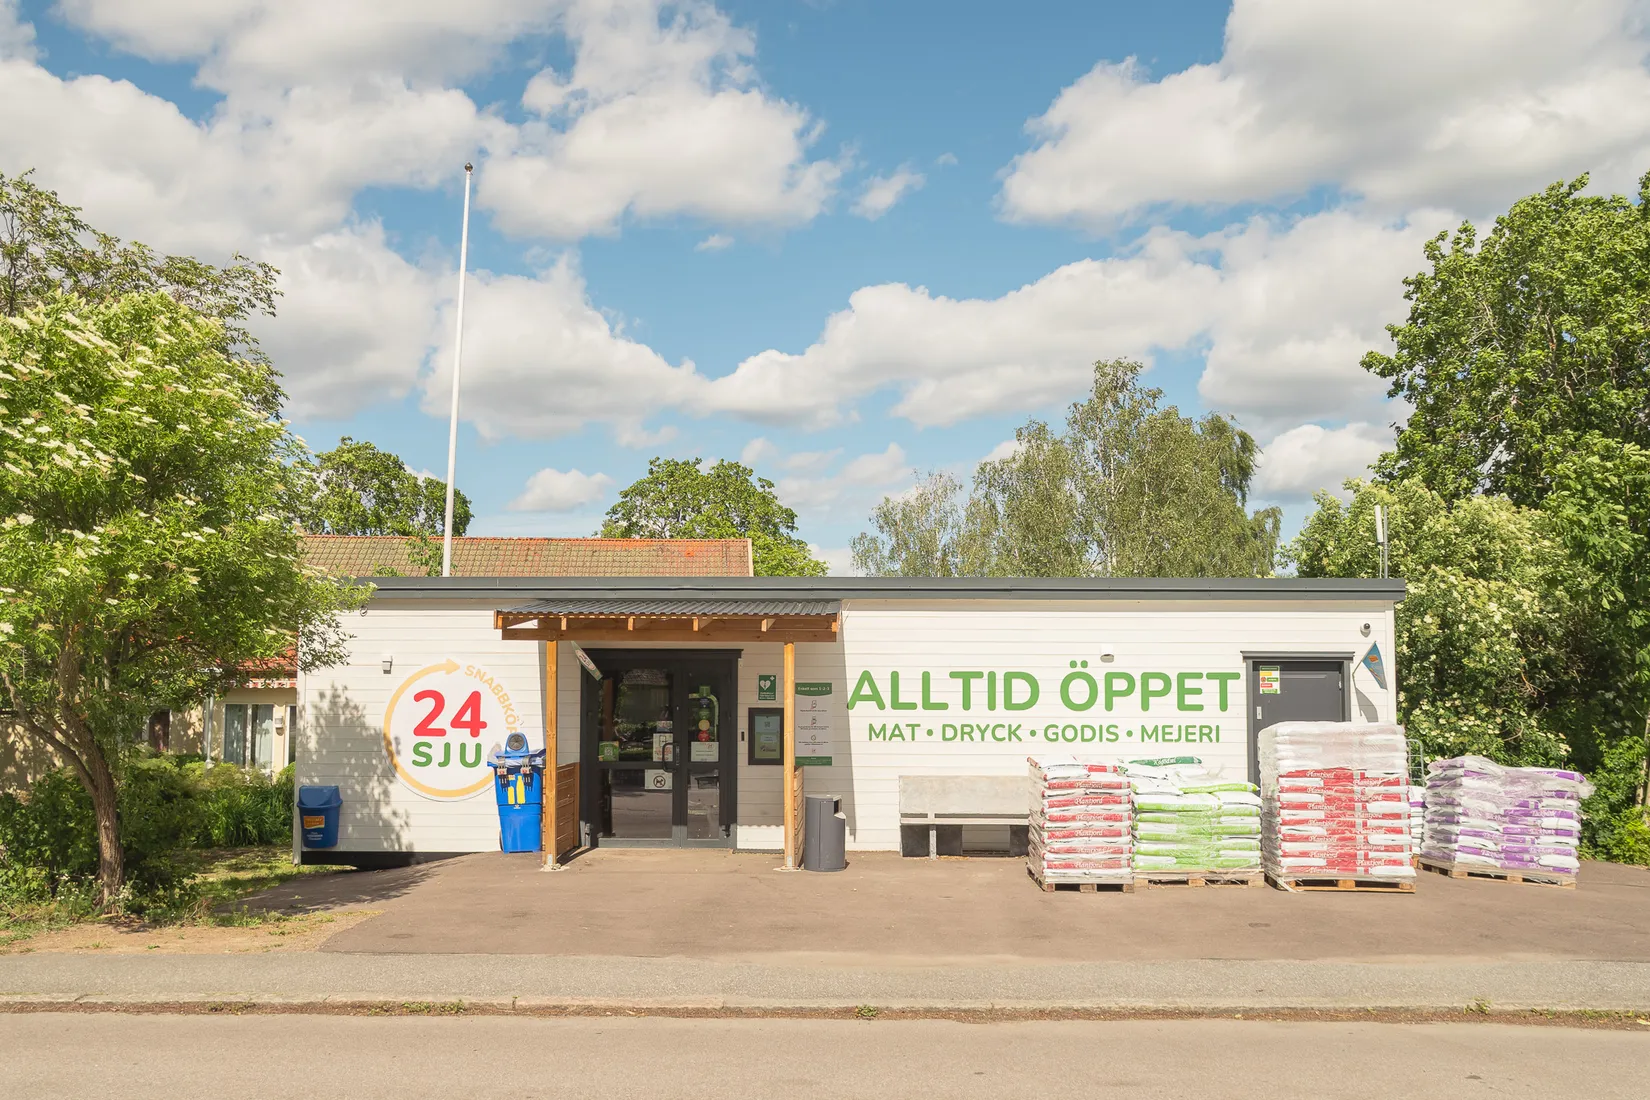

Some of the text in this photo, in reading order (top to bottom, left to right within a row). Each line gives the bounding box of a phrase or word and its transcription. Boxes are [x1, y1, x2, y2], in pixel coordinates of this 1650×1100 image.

[847, 660, 1241, 712] ALLTID ÖPPET
[413, 689, 488, 738] 24
[868, 723, 1220, 743] MAT DRYCK GODIS MEJERI
[412, 741, 482, 768] SJU
